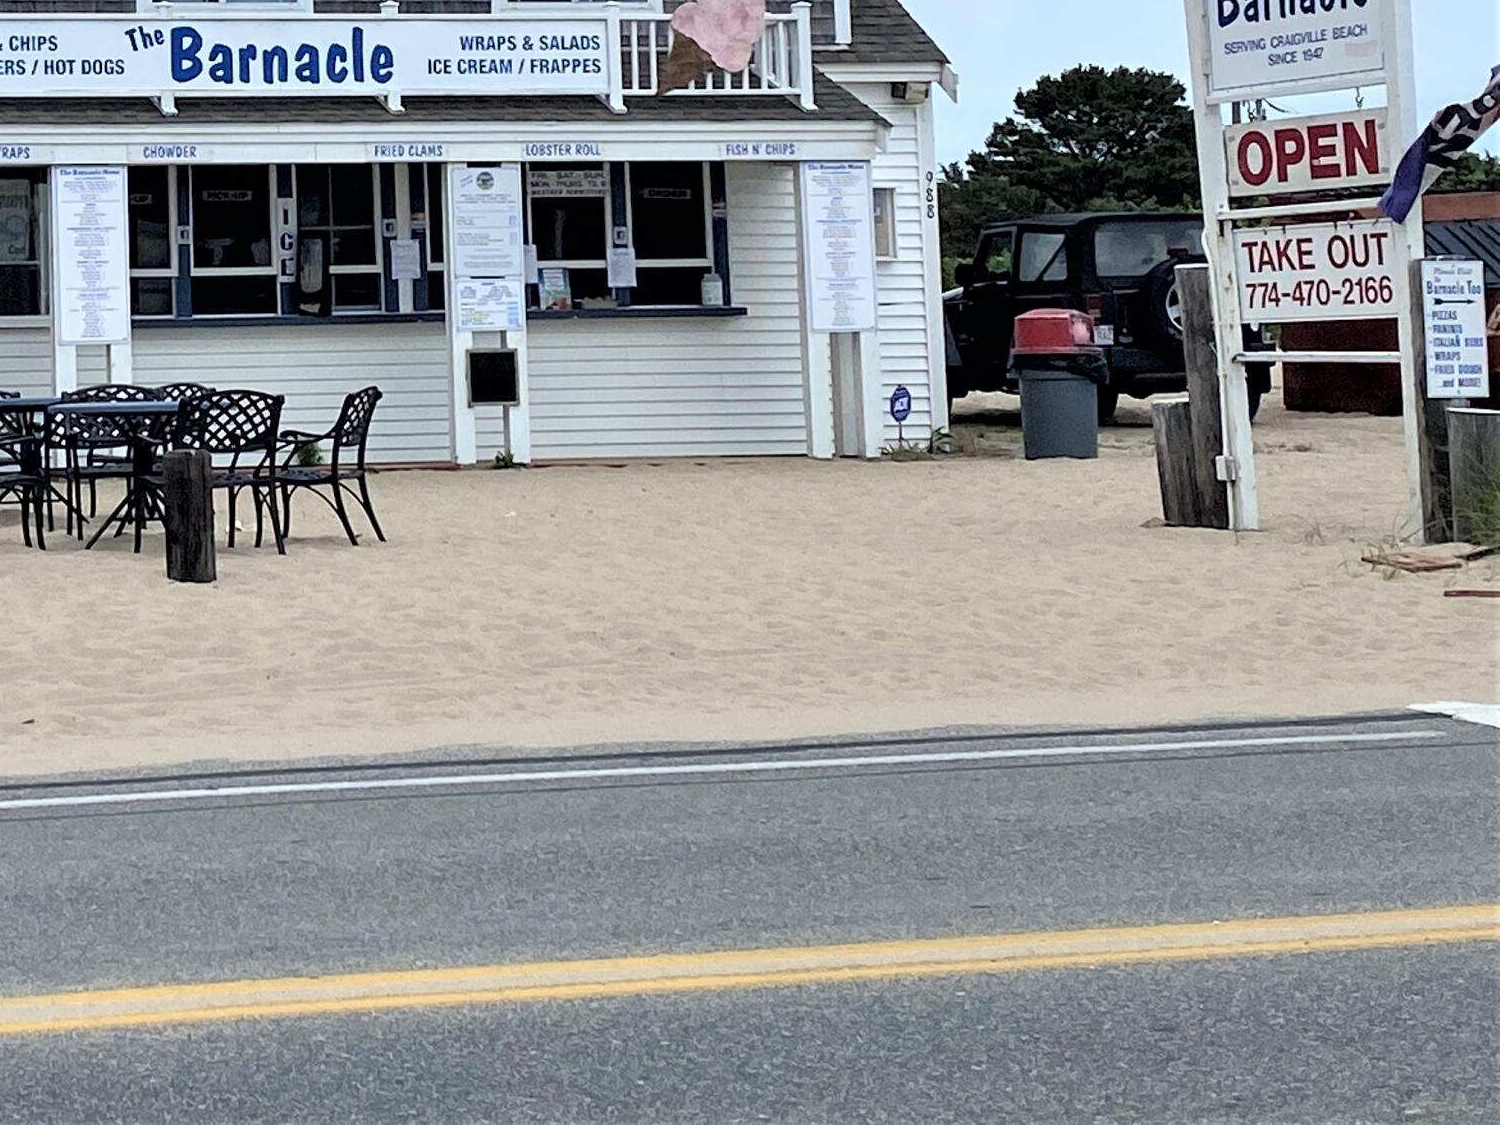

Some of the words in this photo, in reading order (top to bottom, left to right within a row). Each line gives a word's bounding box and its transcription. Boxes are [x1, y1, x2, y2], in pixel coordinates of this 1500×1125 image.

[9, 35, 58, 51] CHIPS
[460, 35, 516, 51] WRAPS
[522, 35, 534, 51] &
[539, 35, 601, 50] SALADS
[1224, 38, 1266, 55] SERVING
[1270, 29, 1328, 49] CRAIGVILLE
[1332, 23, 1368, 40] BEACH
[124, 25, 165, 52] The
[170, 26, 394, 84] Barnacle
[1268, 51, 1298, 66] SINCE
[1302, 47, 1324, 62] 1947
[31, 59, 39, 75] /
[44, 59, 76, 75] HOT
[81, 59, 125, 75] DOGS
[427, 59, 451, 74] ICE
[457, 59, 513, 74] CREAM
[518, 59, 525, 74] /
[530, 58, 601, 73] FRAPPES
[143, 145, 197, 158] CHOWDER
[374, 145, 404, 157] FRIED
[408, 145, 443, 157] CLAMS
[525, 144, 571, 156] LOBSTER
[575, 144, 601, 156] ROLL
[725, 143, 748, 155] FISH
[765, 143, 795, 155] CHIPS
[1237, 119, 1380, 186] OPEN
[280, 208, 294, 276] ICE
[1241, 238, 1316, 273] TAKE
[1327, 232, 1388, 269] OUT
[1246, 275, 1393, 309] 774-470-2166
[1427, 279, 1465, 294] Barnacle
[1467, 280, 1482, 294] Too
[1434, 351, 1460, 361] WRAPS
